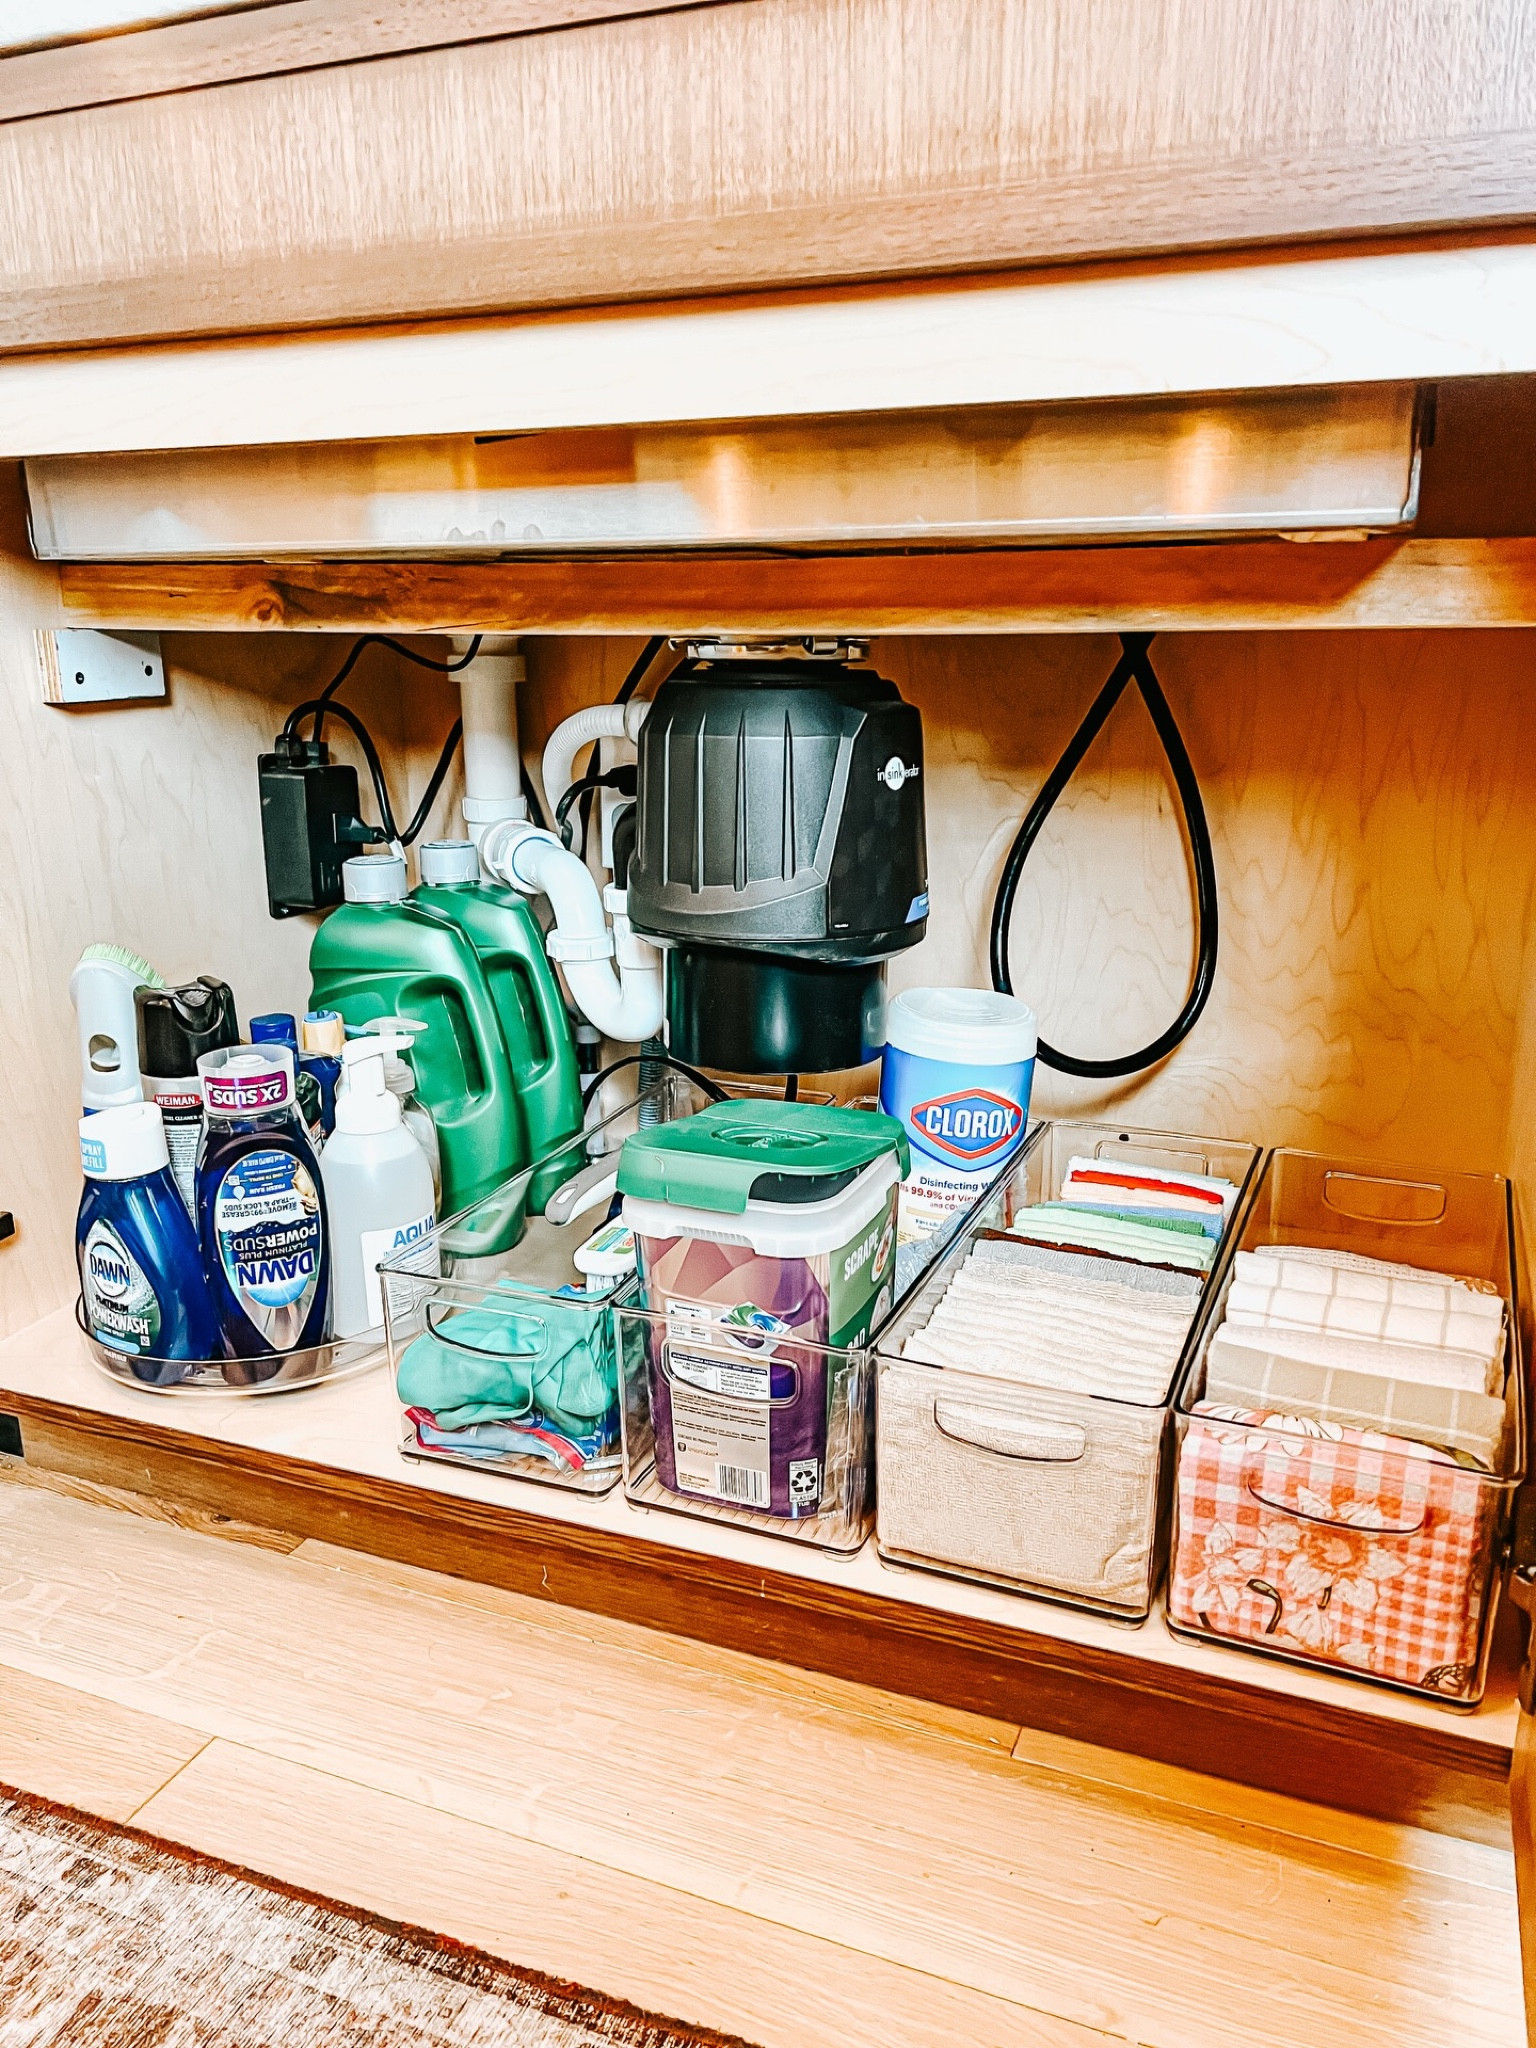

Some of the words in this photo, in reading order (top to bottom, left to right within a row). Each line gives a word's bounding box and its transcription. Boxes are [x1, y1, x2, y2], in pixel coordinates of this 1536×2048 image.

[155, 1096, 196, 1105] WEIMAN
[211, 1090, 258, 1105] SUDS
[260, 1084, 282, 1102] 2X
[925, 1105, 1015, 1139] CLOROX
[920, 1176, 978, 1192] Disinfecting
[911, 1186, 943, 1200] 99.9%
[945, 1193, 955, 1201] of
[222, 1210, 252, 1218] GREASE
[268, 1201, 297, 1212] REMOVE
[223, 1222, 318, 1251] POWERSUDS
[393, 1215, 435, 1248] AQUA
[239, 1251, 262, 1260] PLUS
[265, 1241, 308, 1257] PLATINUM
[844, 1226, 880, 1281] SCRAPE
[90, 1253, 131, 1287] DAWN
[239, 1251, 314, 1286] DAWN
